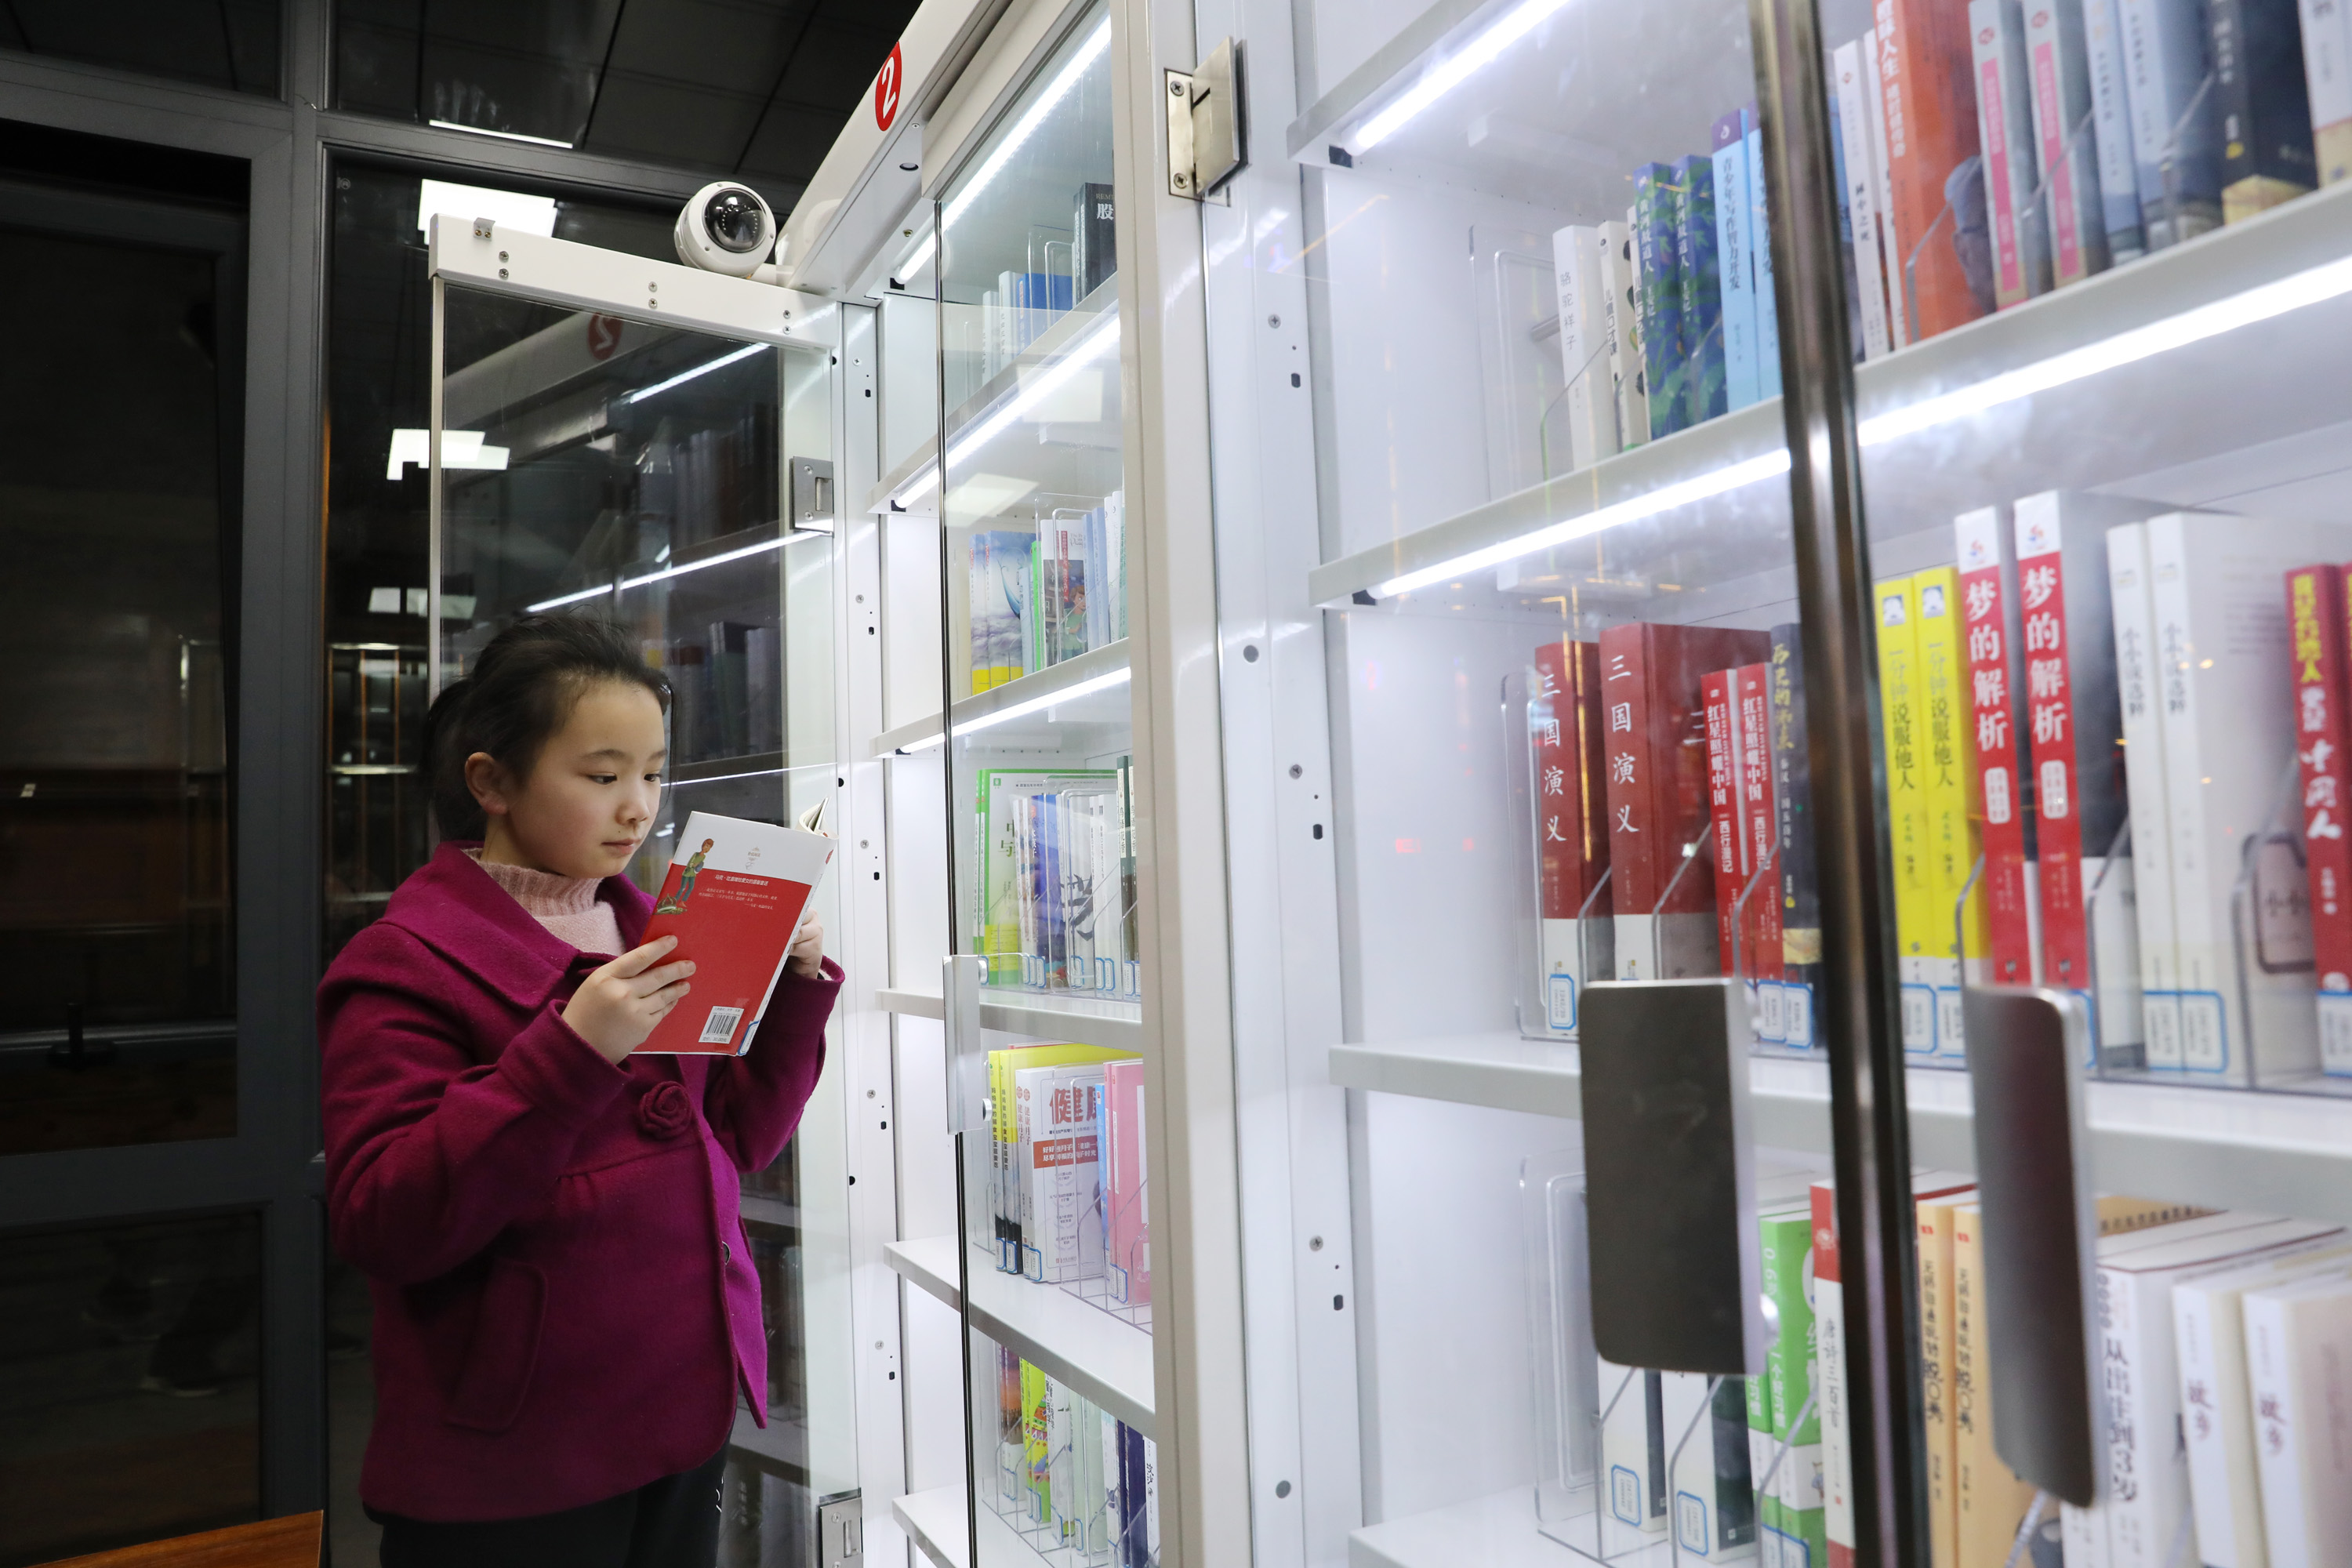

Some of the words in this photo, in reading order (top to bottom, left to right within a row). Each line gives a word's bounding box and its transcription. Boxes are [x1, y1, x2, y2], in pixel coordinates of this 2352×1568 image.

[881, 56, 897, 119] 2
[1559, 270, 1577, 350] 骆驼祥子
[1605, 289, 1618, 357] 儿童口才课
[1888, 649, 1915, 792] 一分钟说服他人
[1927, 642, 1954, 788] 一分钟说服他人
[1965, 579, 2009, 752] 梦的解析
[2023, 564, 2067, 745] 梦的解析
[1541, 673, 1567, 843] 三国演义
[1608, 653, 1640, 834] 三国演义
[1707, 704, 1727, 807] 红星照耀中国
[1743, 696, 1762, 802] 红星照耀中国
[1821, 1316, 1842, 1430] 唐诗三百首
[2103, 1336, 2139, 1503] 从出生到3岁
